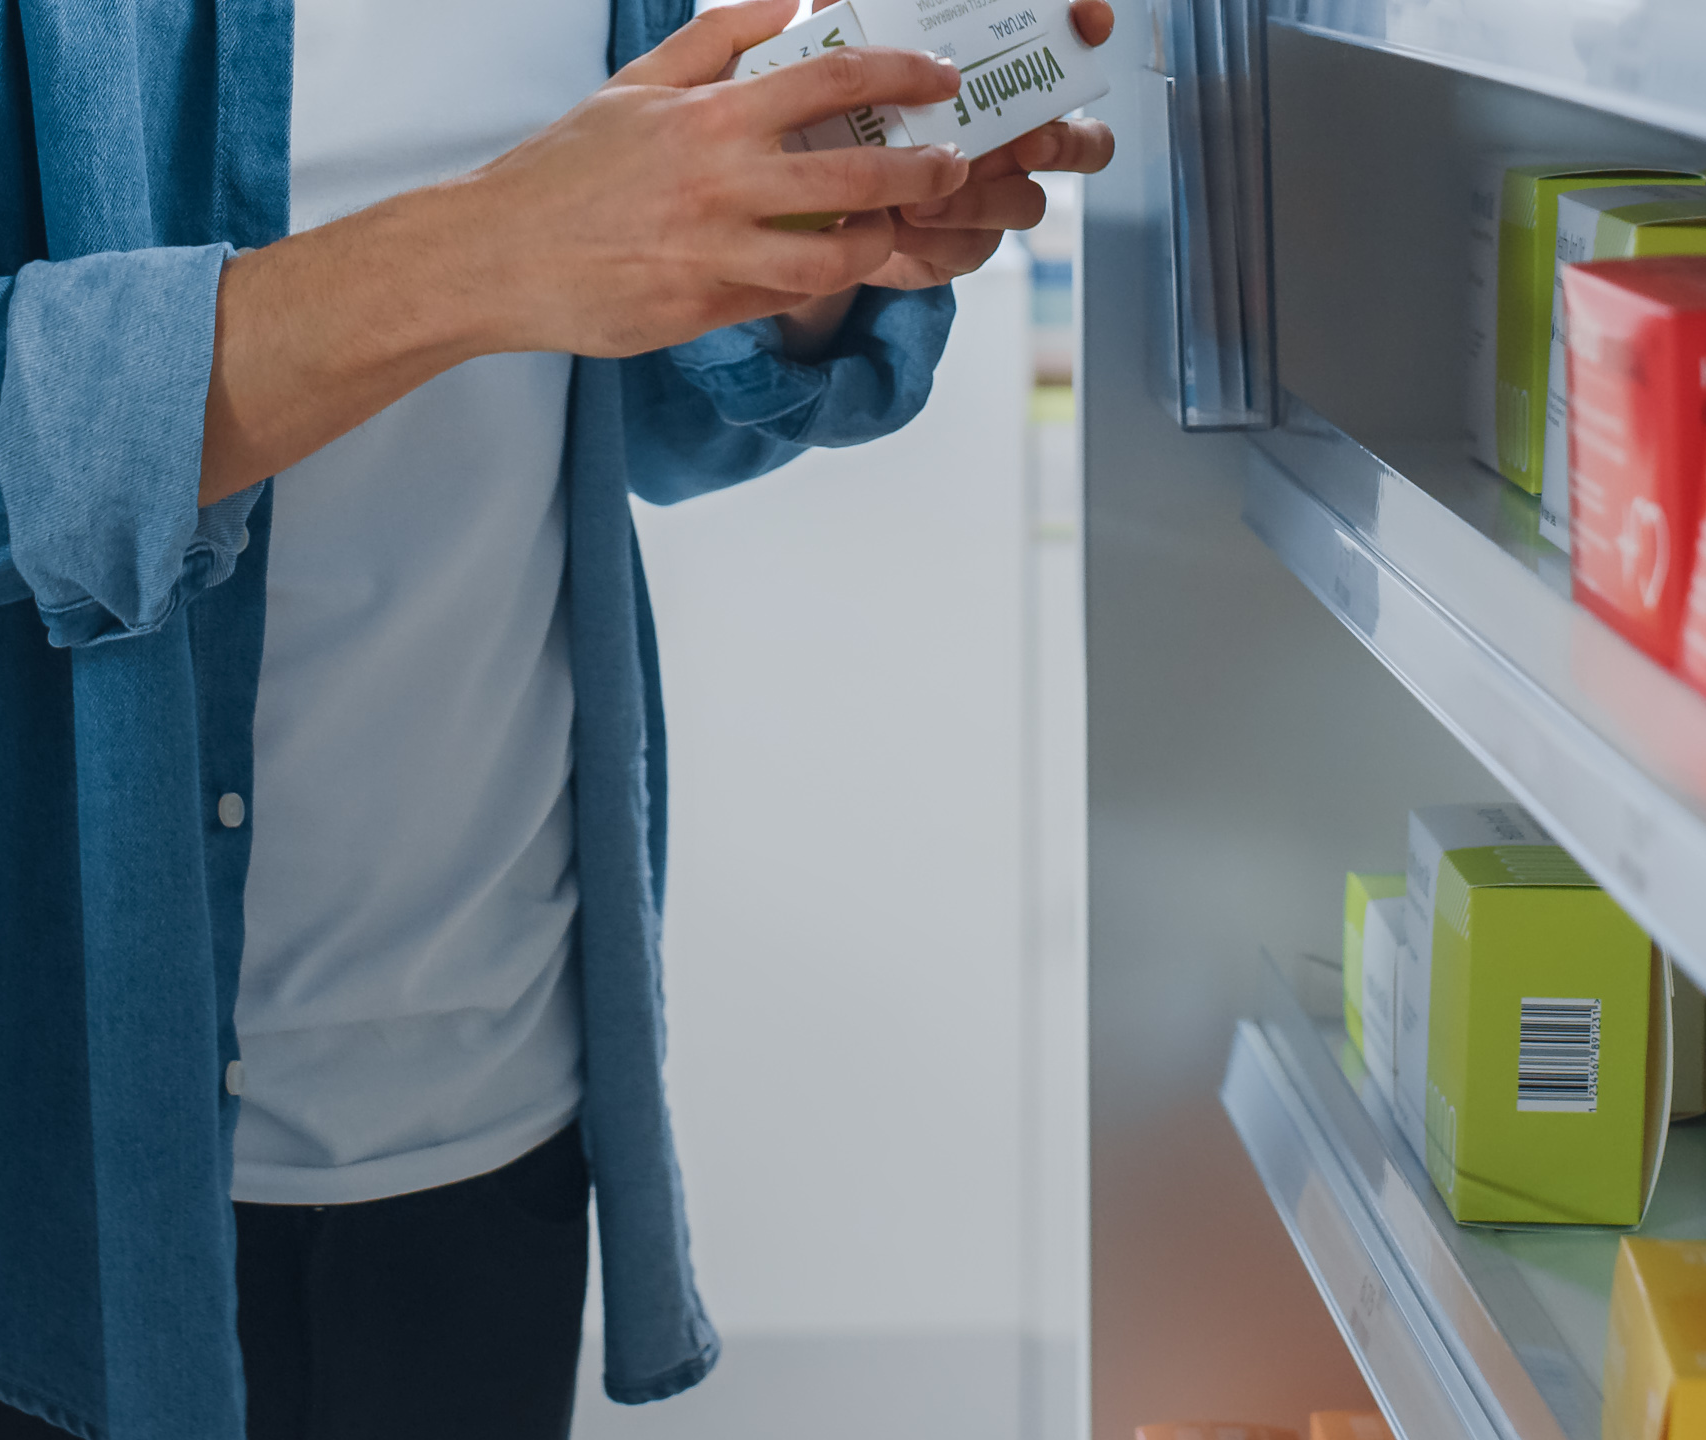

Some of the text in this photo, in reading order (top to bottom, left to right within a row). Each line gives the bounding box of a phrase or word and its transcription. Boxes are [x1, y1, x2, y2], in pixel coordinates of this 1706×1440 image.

[917, 1, 969, 31] MEMBRANES,
[988, 8, 1037, 40] NATURAL
[966, 46, 1065, 117] Vitamin
[1589, 1056, 1600, 1097] 234567
